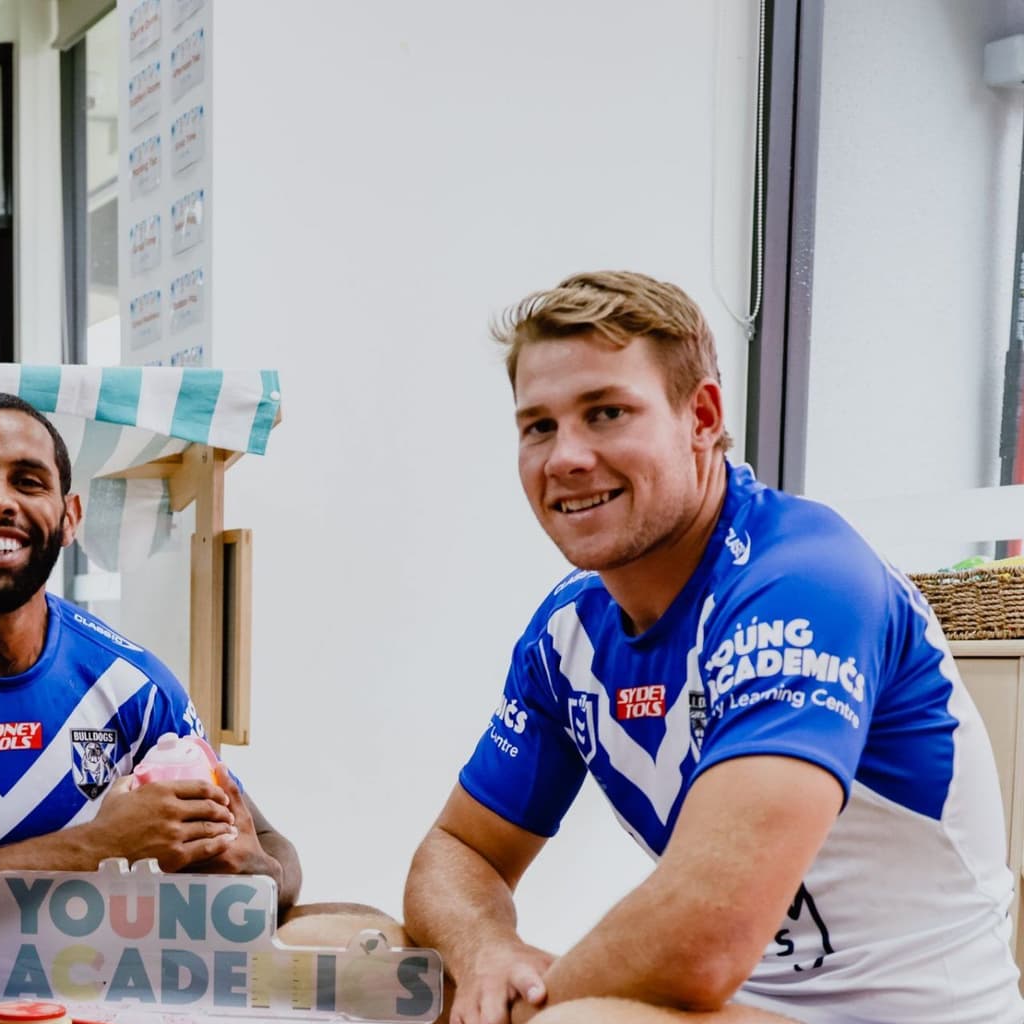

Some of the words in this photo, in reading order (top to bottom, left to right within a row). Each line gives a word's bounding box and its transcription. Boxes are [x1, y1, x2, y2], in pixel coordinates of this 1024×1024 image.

[626, 701, 662, 719] TOLS
[73, 731, 114, 742] BULLDOGS
[5, 878, 266, 943] YOUNG
